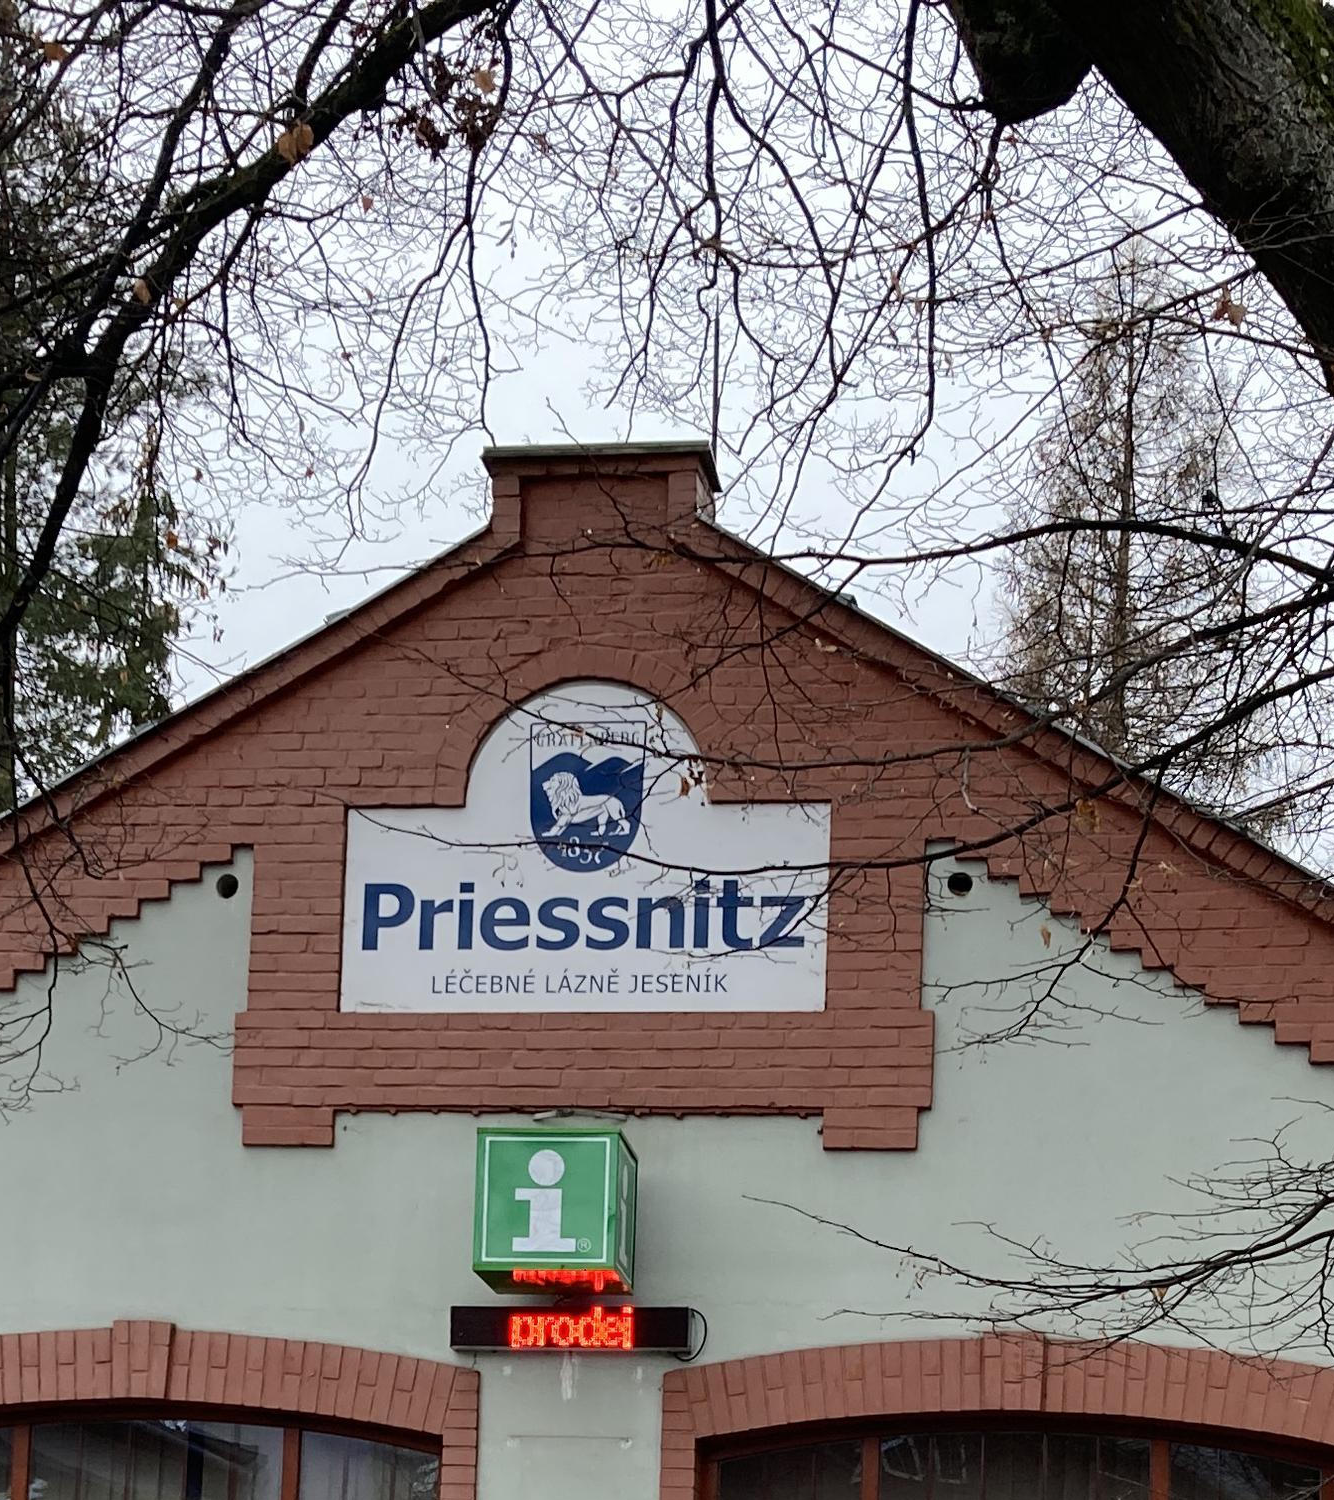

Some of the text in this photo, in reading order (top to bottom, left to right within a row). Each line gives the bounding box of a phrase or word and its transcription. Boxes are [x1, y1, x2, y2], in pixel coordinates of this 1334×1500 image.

[361, 879, 806, 952] Priessnitz
[431, 967, 728, 994] LÉČEBNÉ LÁZNĚ JESENÍK
